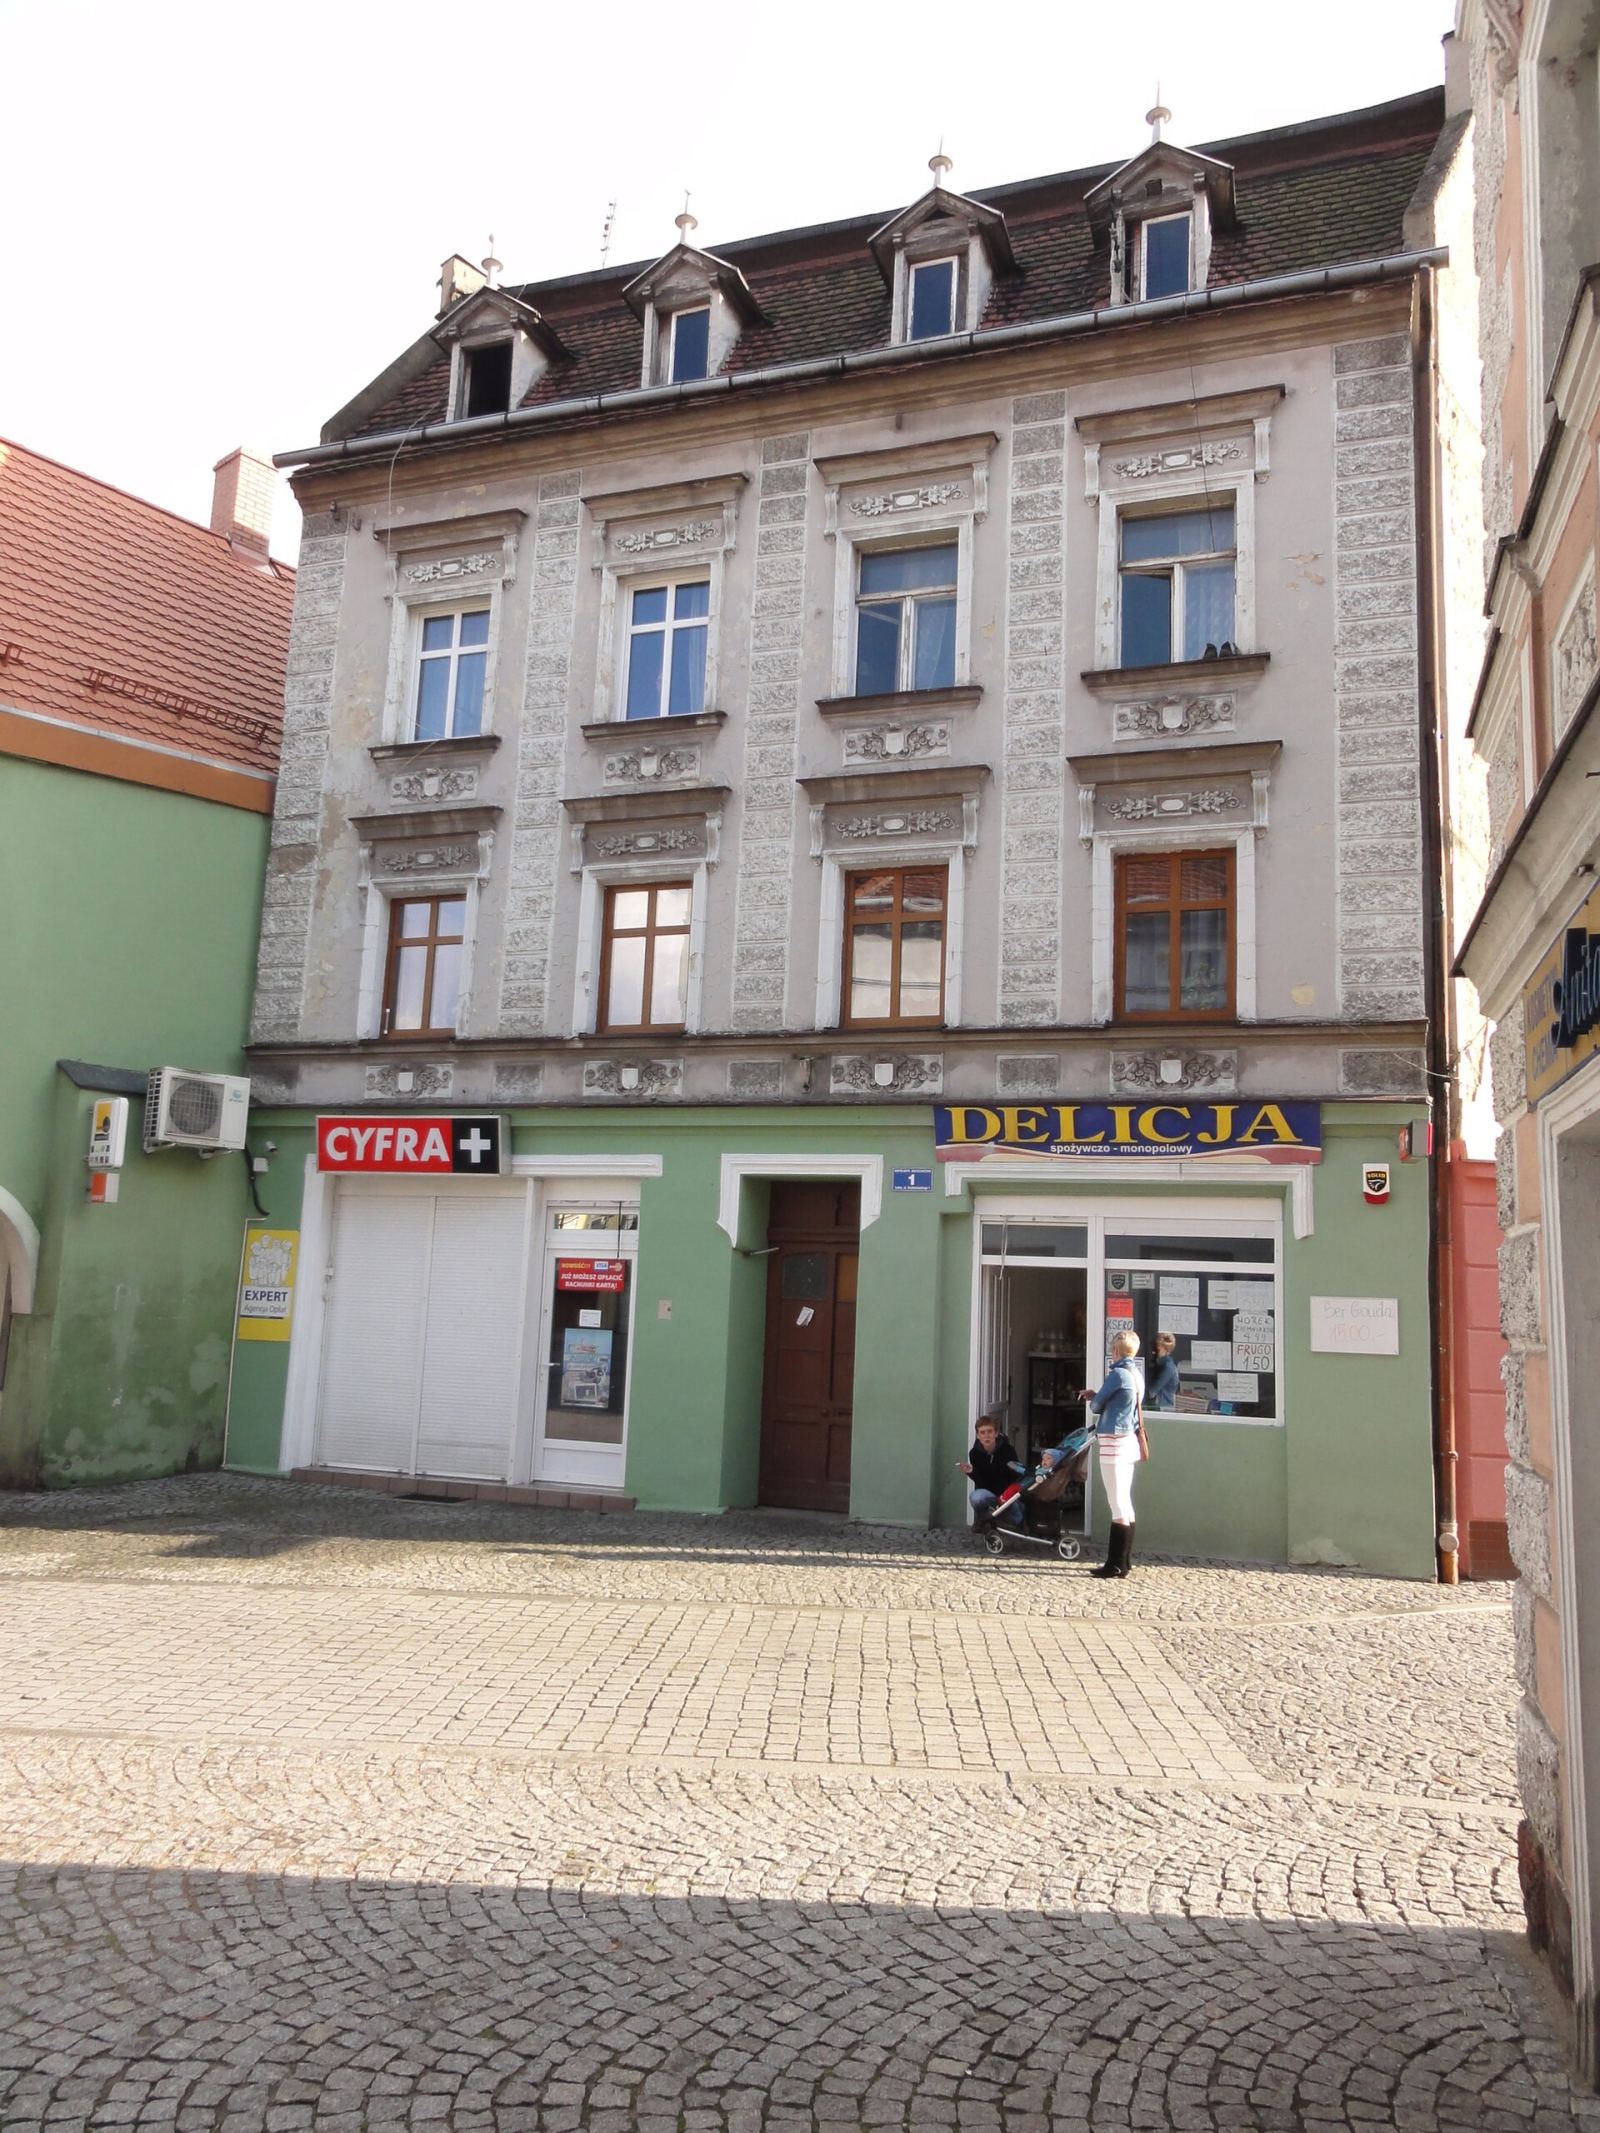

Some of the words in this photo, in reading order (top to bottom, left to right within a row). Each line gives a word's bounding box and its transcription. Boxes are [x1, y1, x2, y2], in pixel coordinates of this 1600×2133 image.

[945, 1104, 1303, 1143] DELICJA
[326, 1126, 450, 1162] CYFRA
[1050, 1143, 1111, 1155] spożywczo
[1120, 1143, 1193, 1155] monopolowy
[908, 1173, 915, 1186] 1
[244, 1290, 288, 1303] EXPERT
[1107, 1319, 1133, 1331] KSERO
[1237, 1344, 1271, 1356] FRUGO
